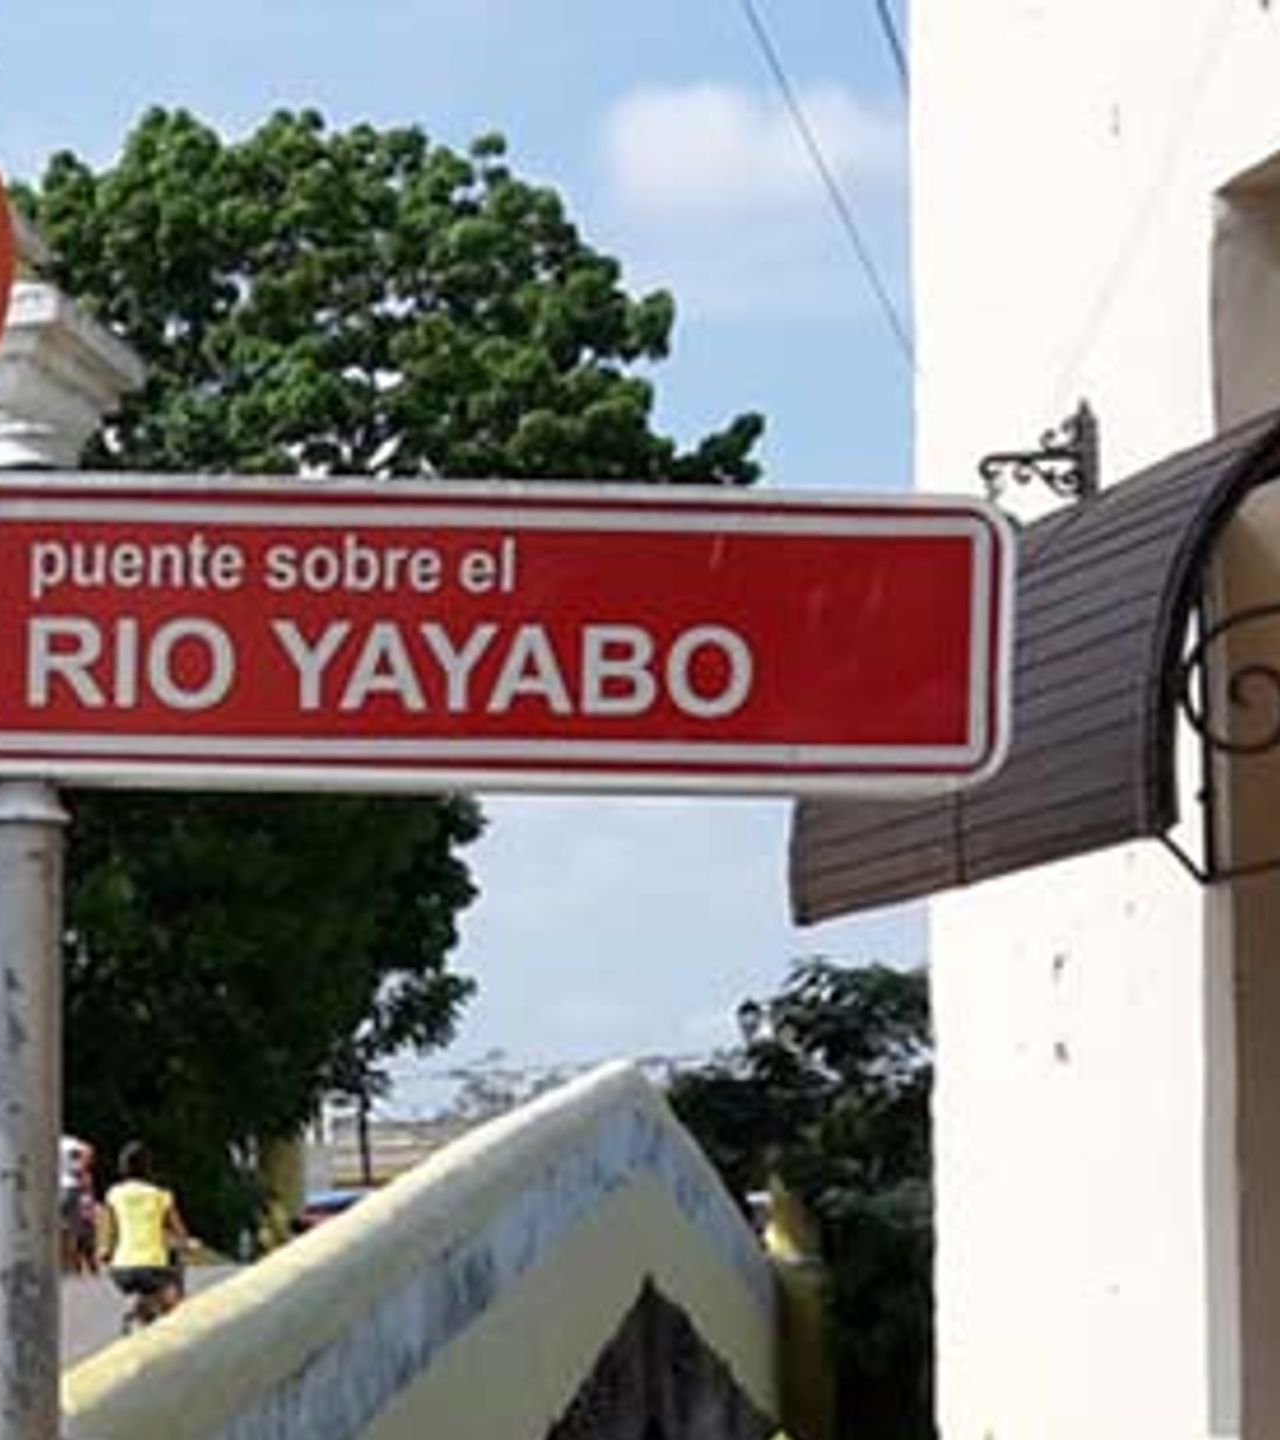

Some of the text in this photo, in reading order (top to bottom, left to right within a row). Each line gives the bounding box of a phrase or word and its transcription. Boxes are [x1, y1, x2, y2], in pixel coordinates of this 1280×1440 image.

[29, 534, 515, 599] puente sobre el
[26, 616, 752, 718] RIO YAYABO
